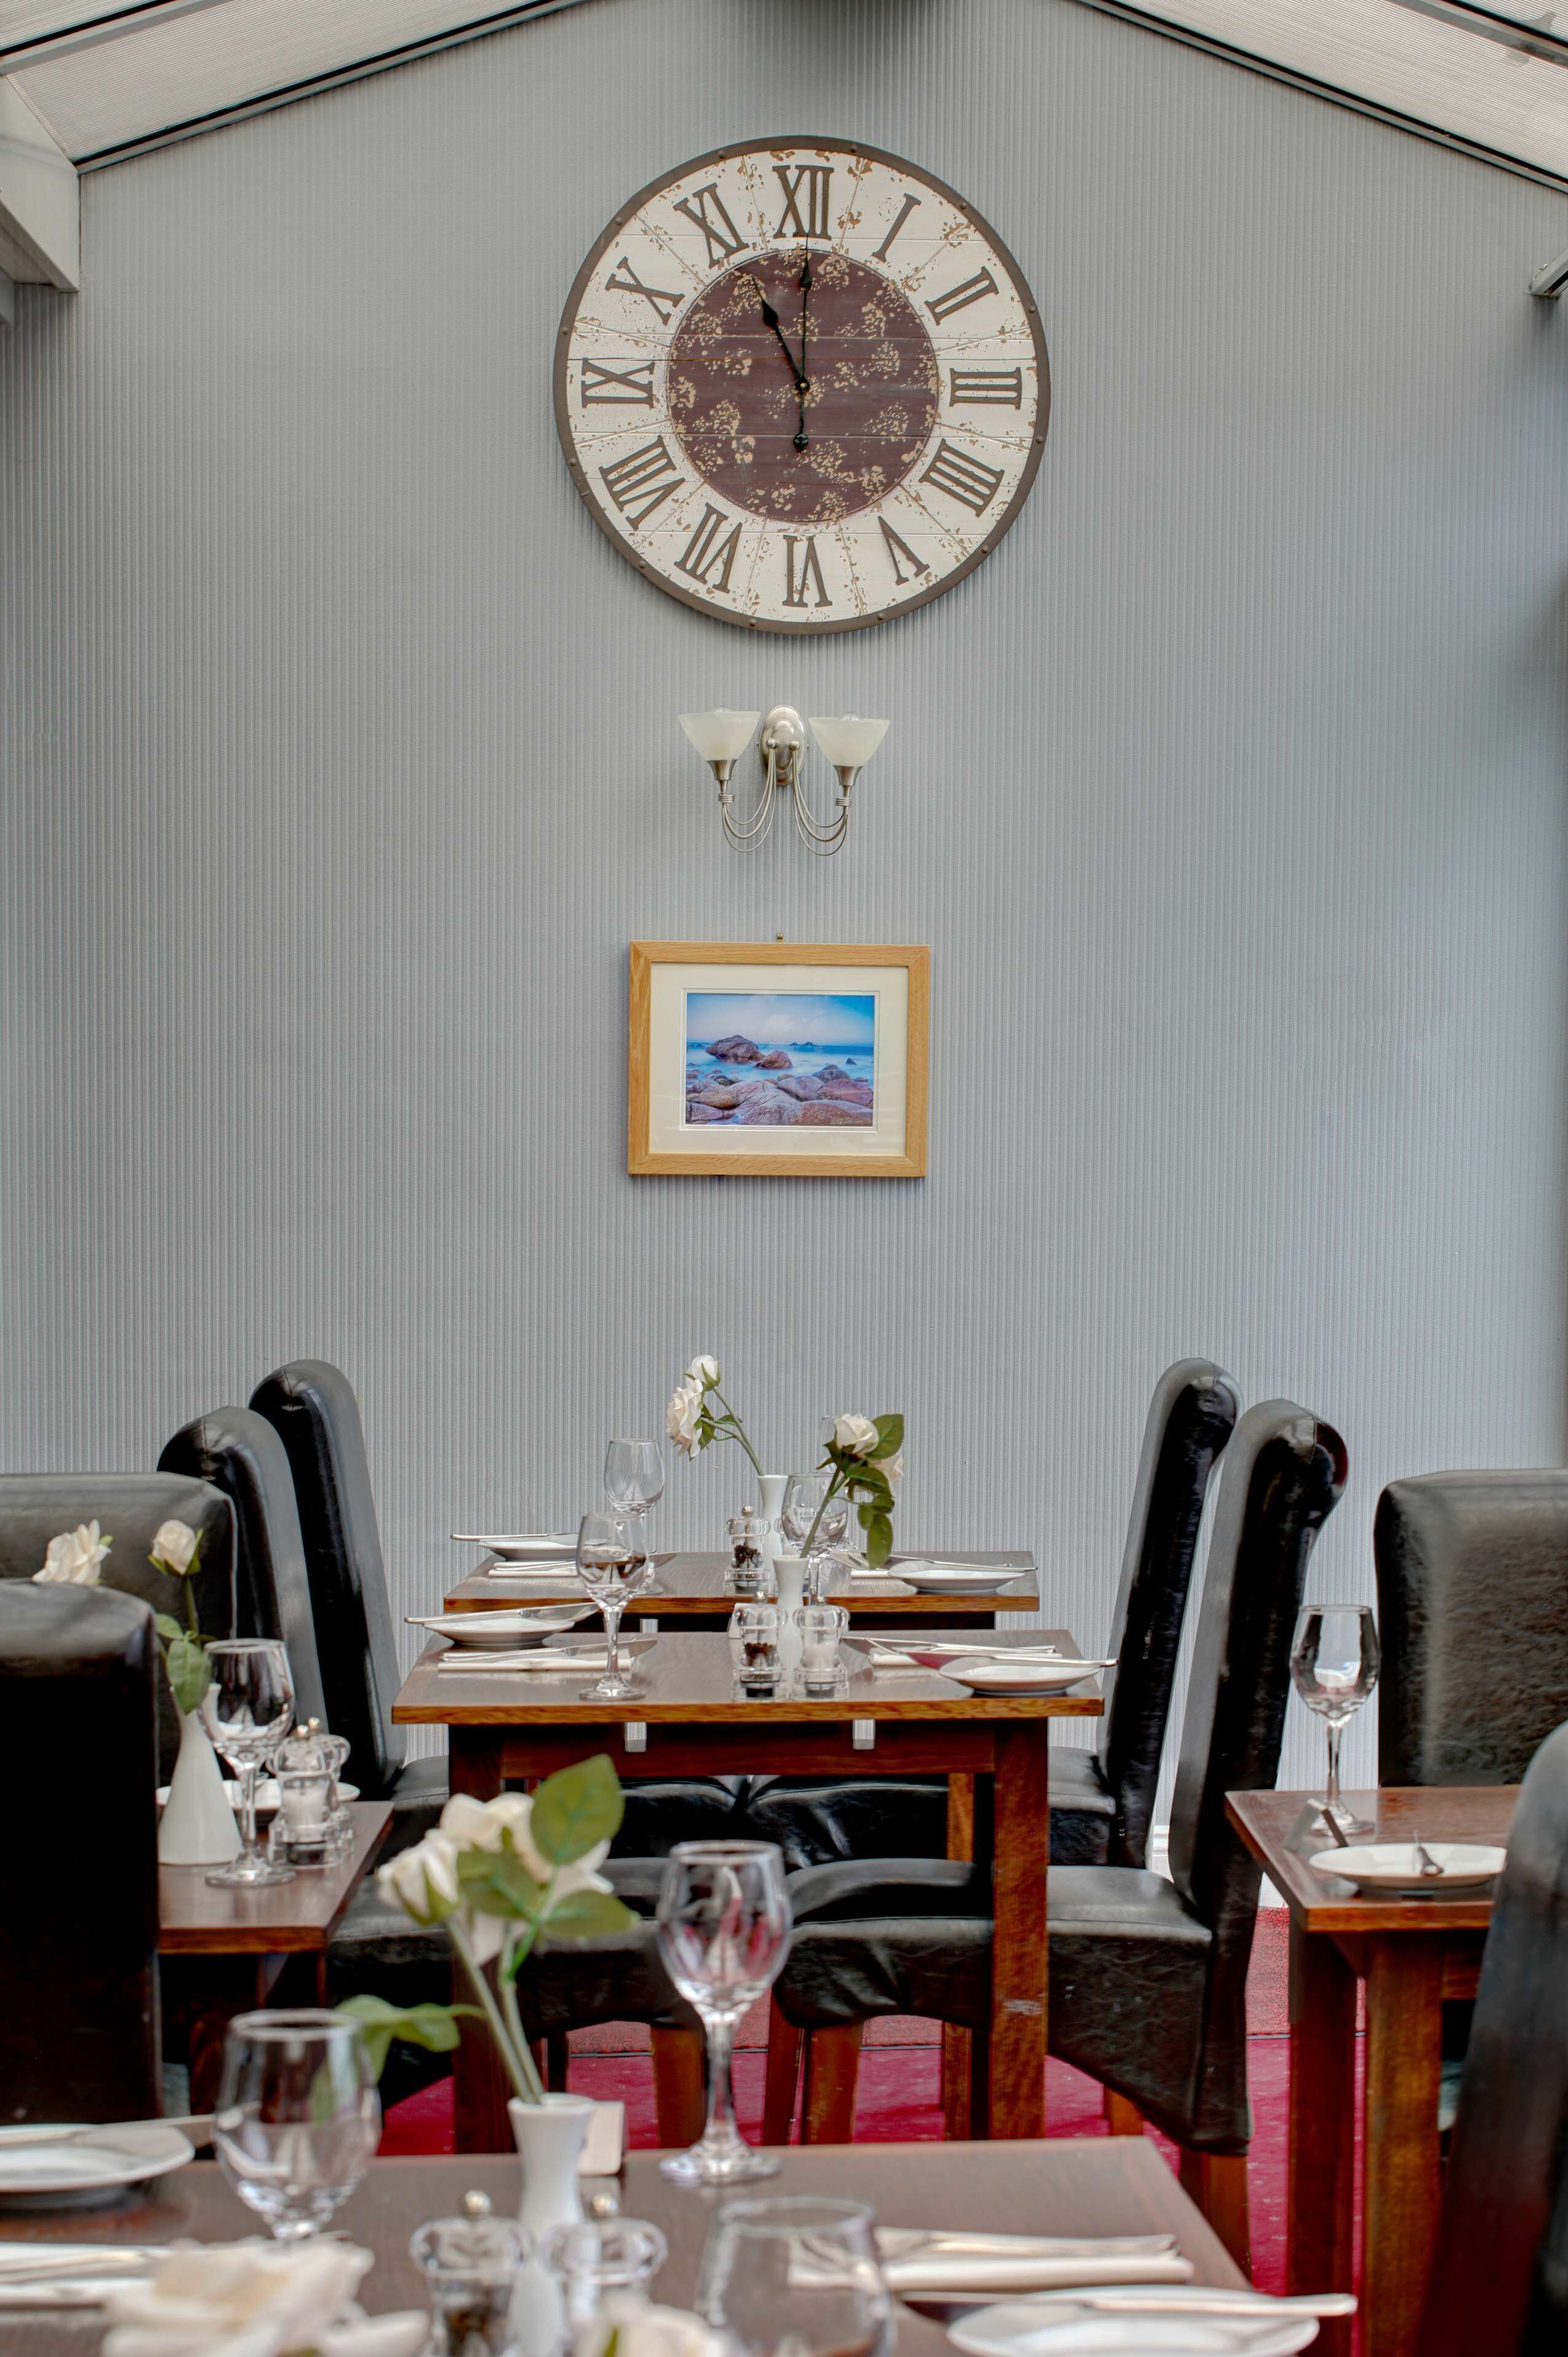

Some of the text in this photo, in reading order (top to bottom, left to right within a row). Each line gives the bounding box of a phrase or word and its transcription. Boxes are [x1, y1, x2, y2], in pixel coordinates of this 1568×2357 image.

[673, 183, 750, 268] XI
[772, 165, 834, 240] XII
[873, 193, 922, 262] I
[606, 257, 685, 325] X
[925, 266, 999, 325] II
[581, 357, 655, 408] IX
[950, 367, 1022, 409] III
[599, 435, 686, 530] VIII
[918, 439, 1005, 517] IIII
[675, 502, 742, 594] VII
[782, 535, 833, 608] VI
[878, 516, 930, 585] V
